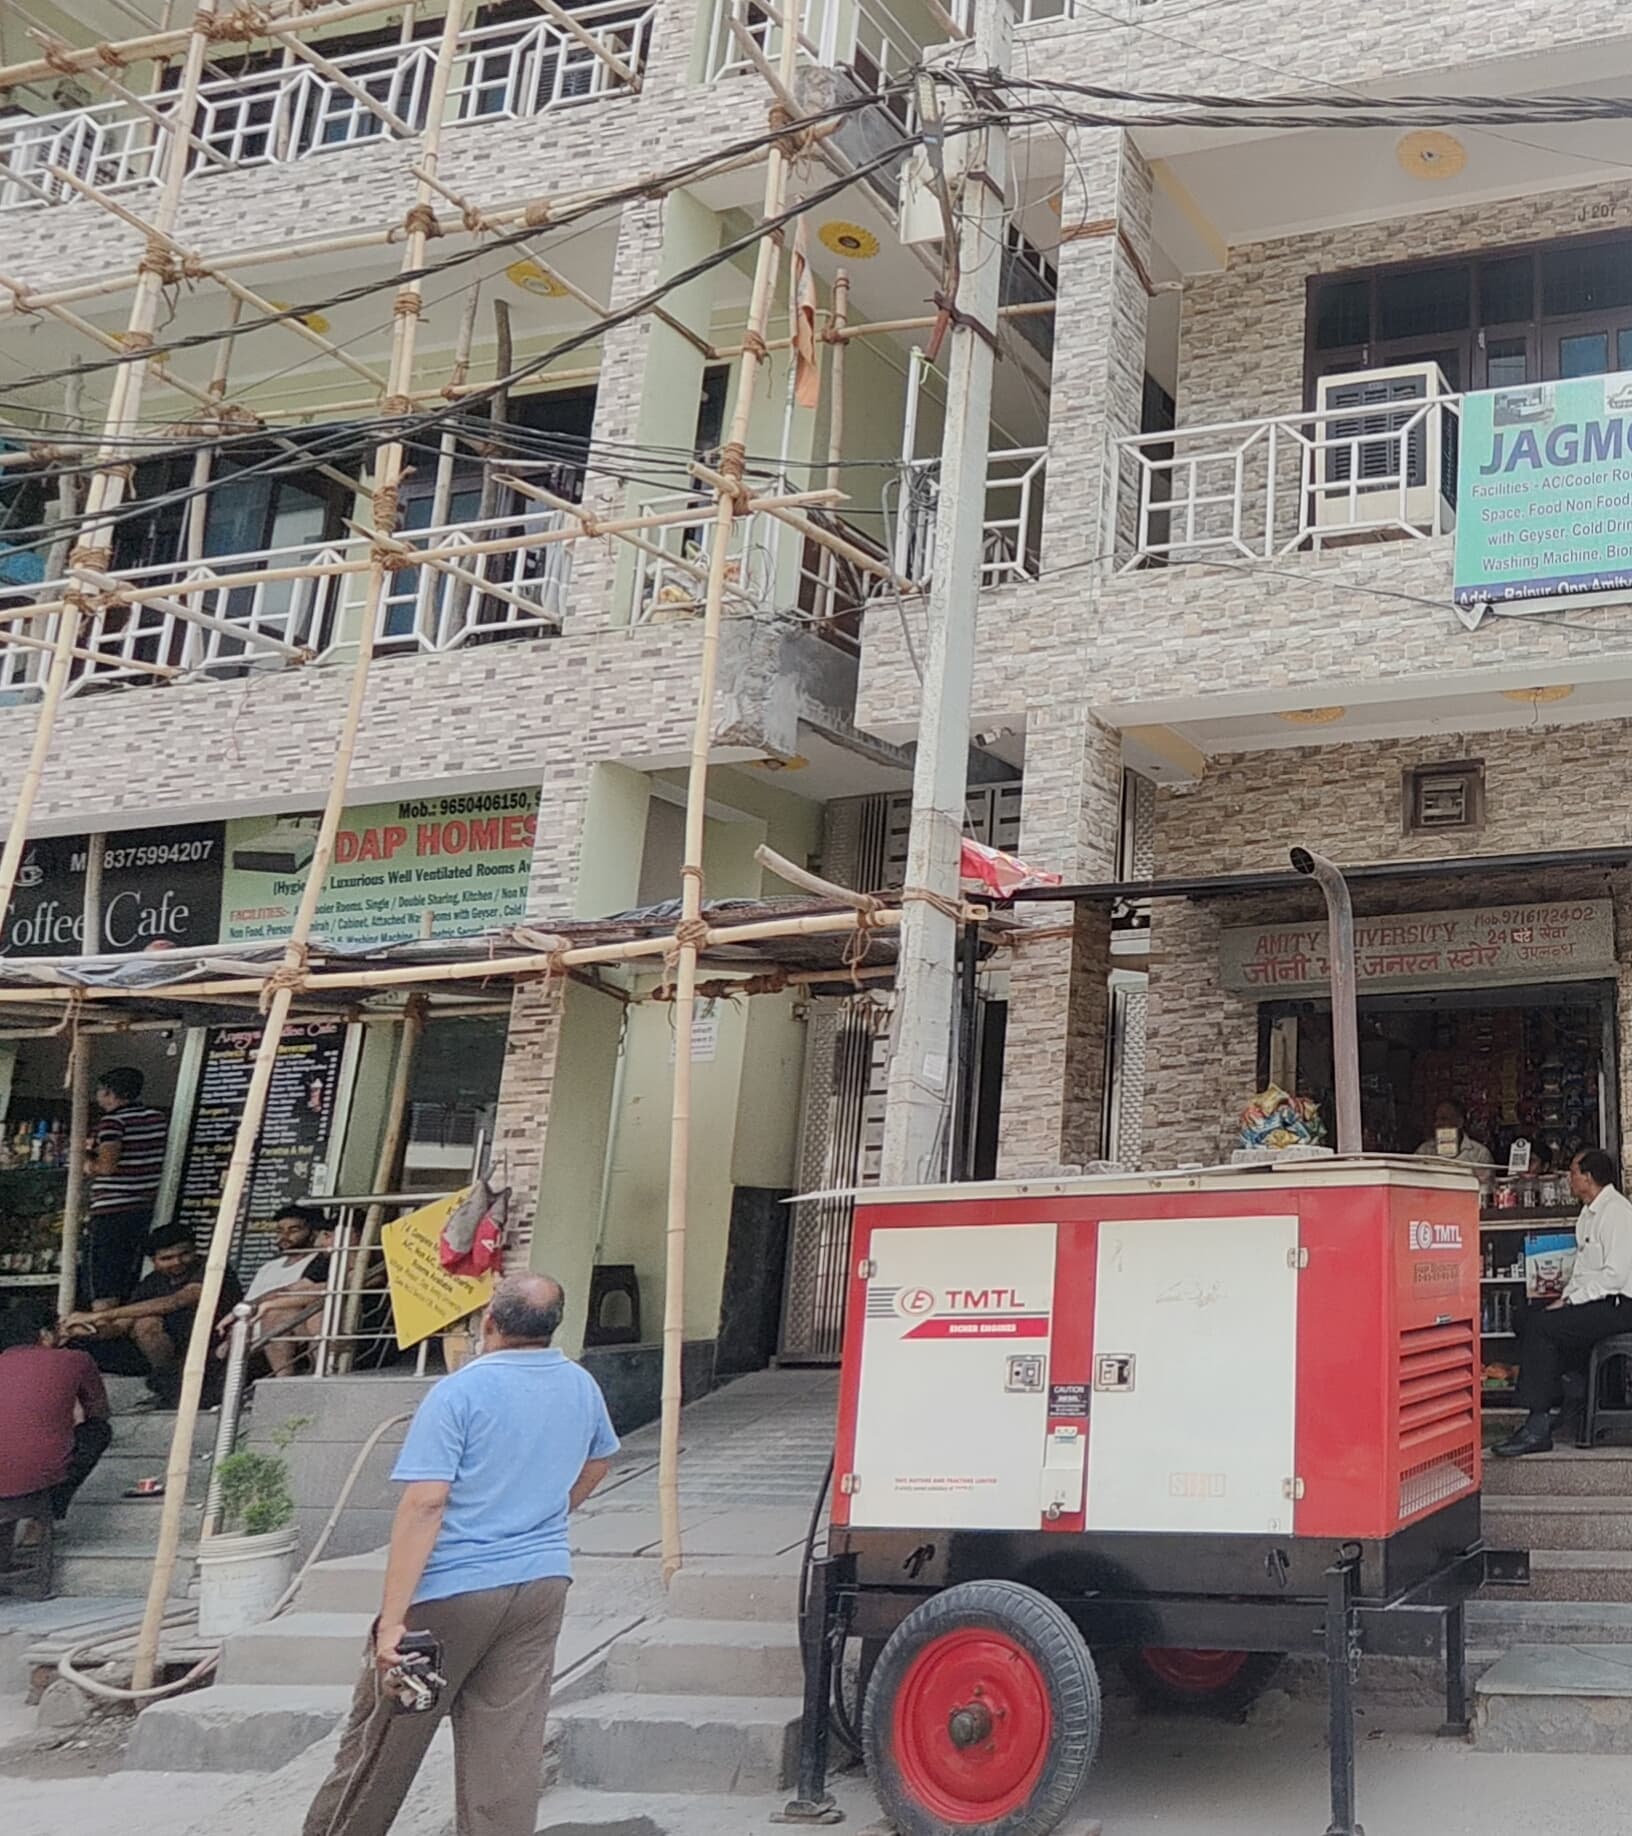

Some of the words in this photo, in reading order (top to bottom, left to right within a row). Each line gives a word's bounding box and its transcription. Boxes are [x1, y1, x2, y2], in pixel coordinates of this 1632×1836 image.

[1541, 474, 1608, 490] AC/Cooler
[1529, 502, 1562, 517] Food
[1566, 498, 1593, 512] Non
[1488, 531, 1515, 546] with
[1573, 520, 1603, 536] Cold
[1482, 554, 1539, 573] Washing
[440, 792, 532, 817] 9650406150,
[416, 815, 538, 856] HOMES
[104, 840, 214, 870] 8375994207
[330, 874, 385, 890] Luxurious
[388, 869, 413, 884] Well
[415, 865, 473, 883] Ventilated
[476, 861, 515, 878] Rooms
[104, 889, 190, 947] Cafe
[1256, 931, 1322, 955] AMITY
[1487, 929, 1507, 944] 24
[1539, 923, 1569, 939] सेवा
[1363, 950, 1441, 976] जनरल
[1447, 941, 1501, 969] स्टोर
[1434, 1224, 1462, 1242] TMTL
[944, 1288, 1025, 1309] TMTL
